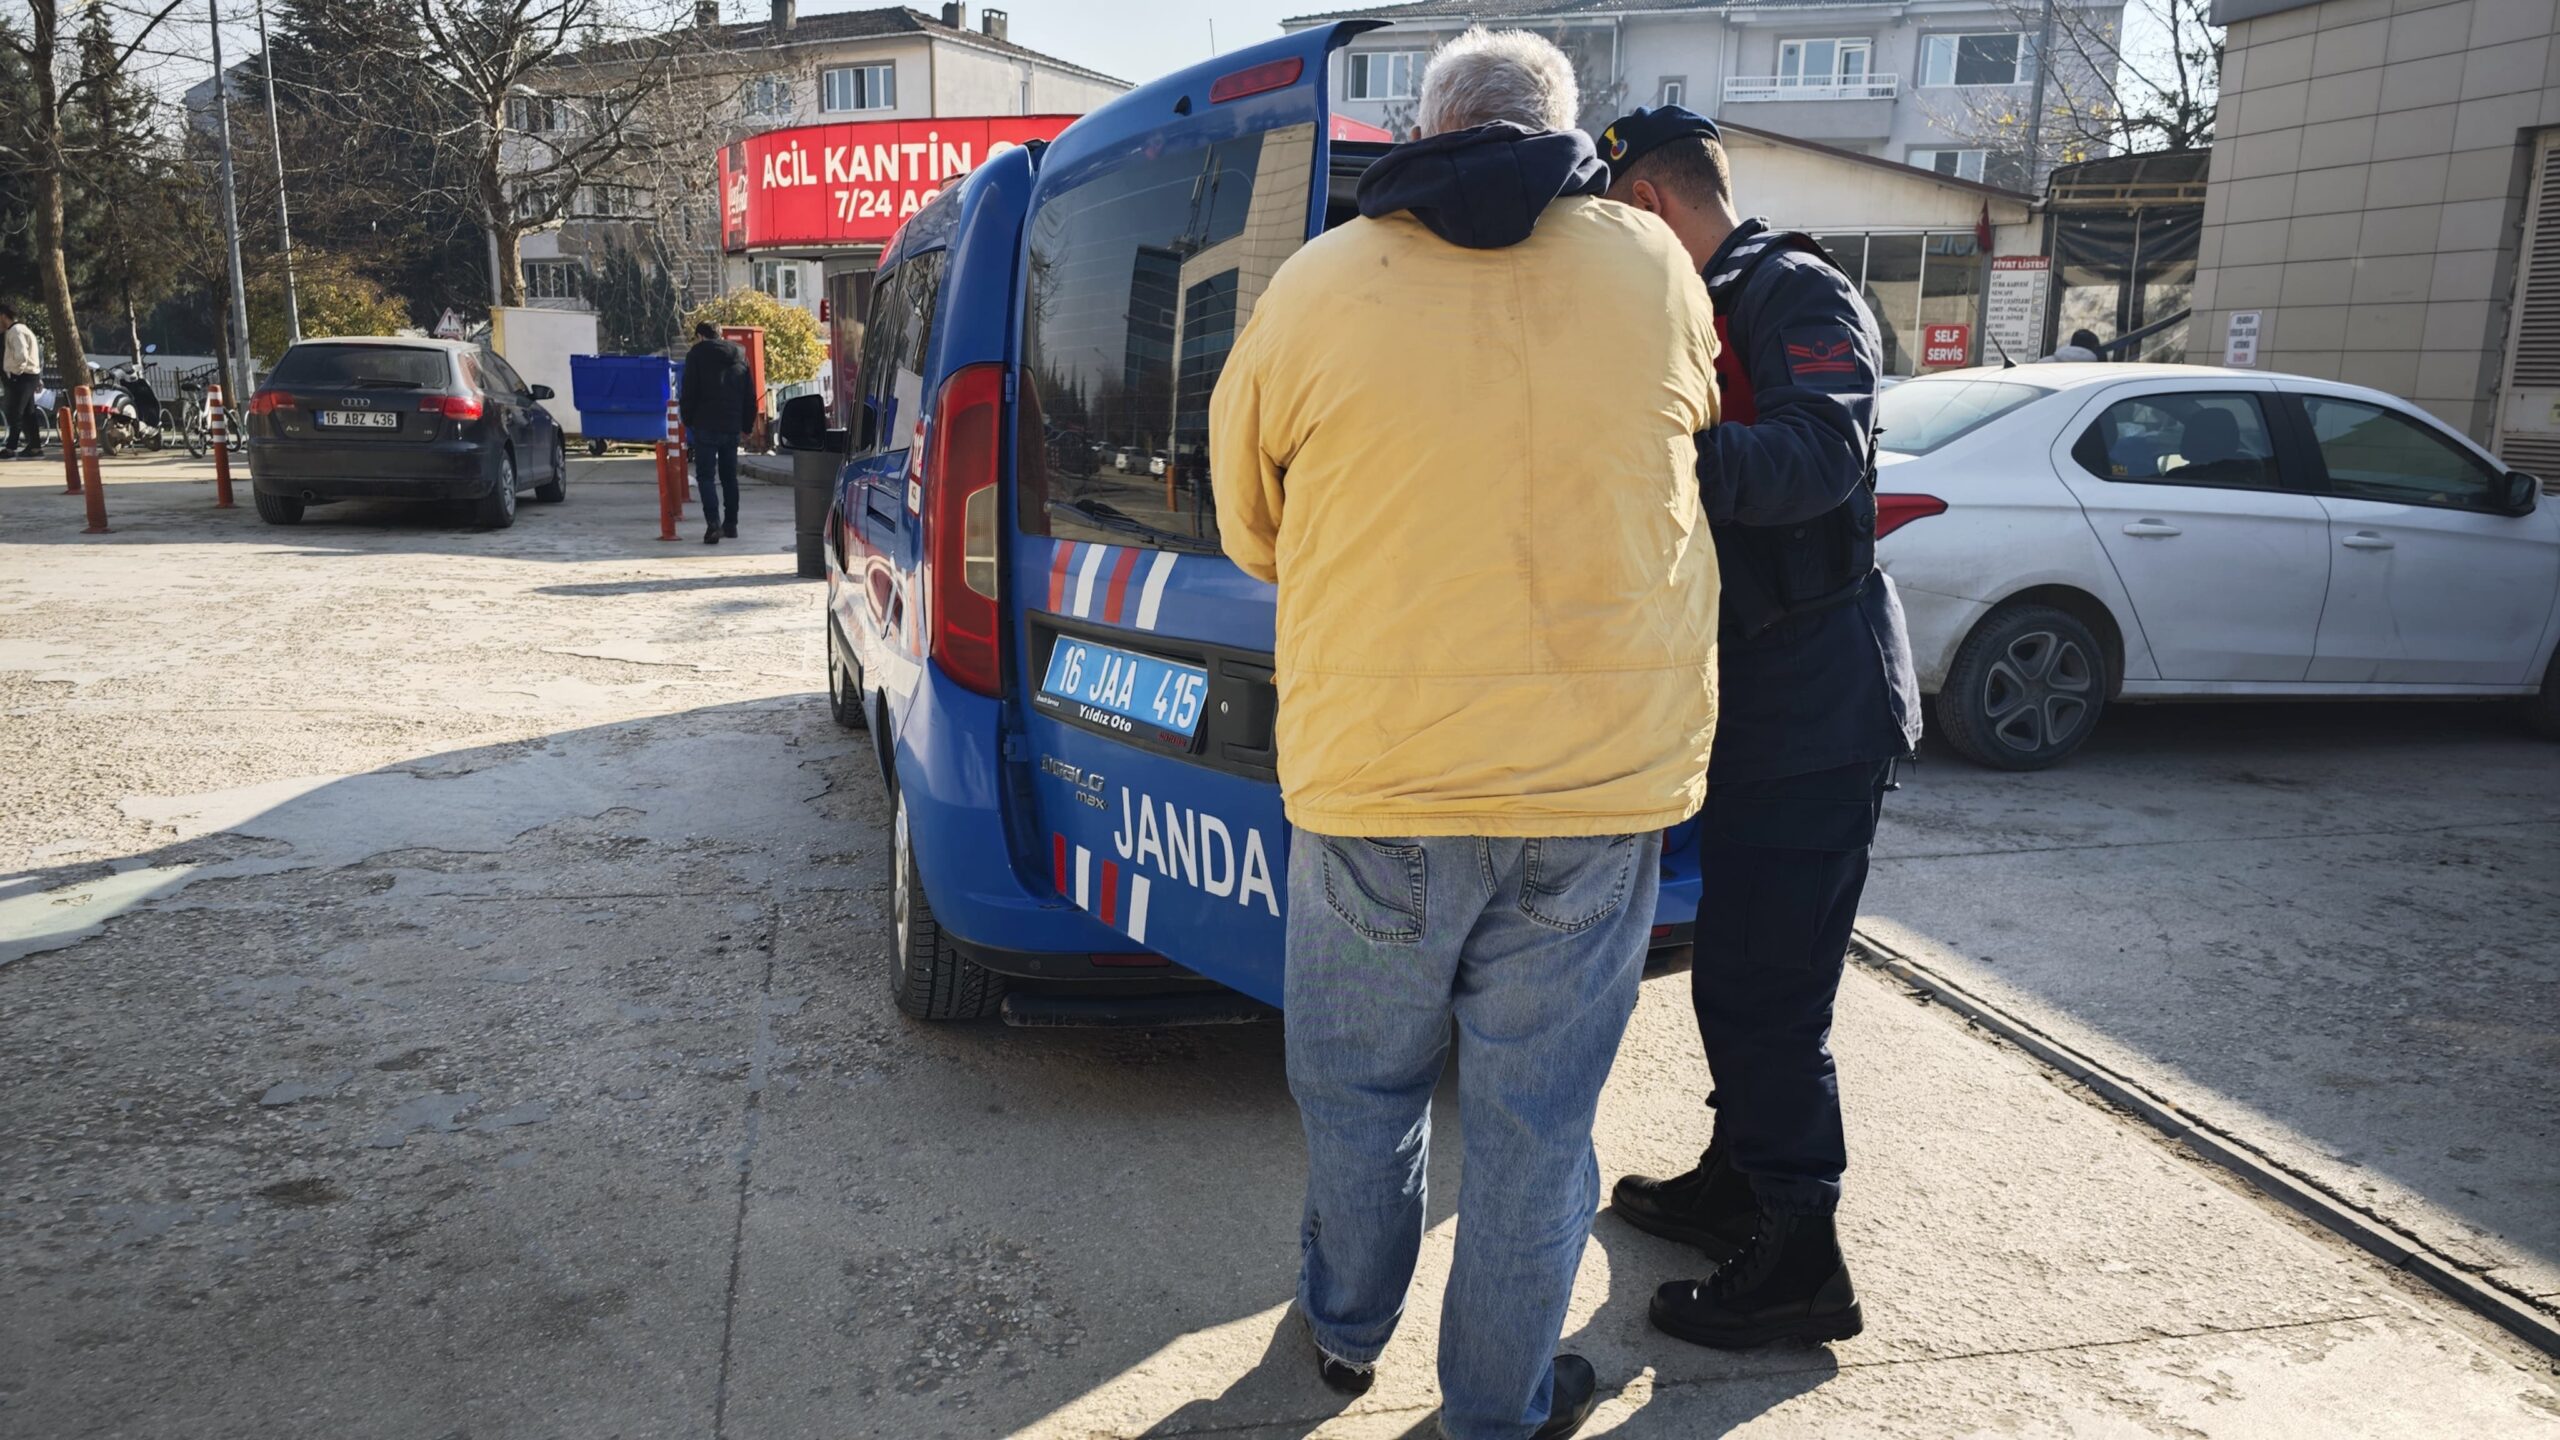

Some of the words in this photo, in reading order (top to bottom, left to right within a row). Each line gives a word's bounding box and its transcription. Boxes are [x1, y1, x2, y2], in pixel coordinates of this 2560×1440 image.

[762, 139, 817, 190] ACİL
[825, 131, 972, 184] KANTİN
[835, 188, 893, 223] 7/24
[1934, 329, 1960, 343] SELF
[1927, 345, 1963, 361] SERVİS
[325, 412, 338, 425] 16
[344, 412, 367, 425] ABZ
[372, 413, 395, 426] 436
[1059, 645, 1087, 695] 16
[1089, 654, 1138, 711] JAA
[1152, 669, 1204, 729] 415
[1078, 704, 1109, 726] Yıldız
[1110, 714, 1133, 733] Oto
[1076, 790, 1105, 811] max
[1113, 786, 1281, 918] JANDA
